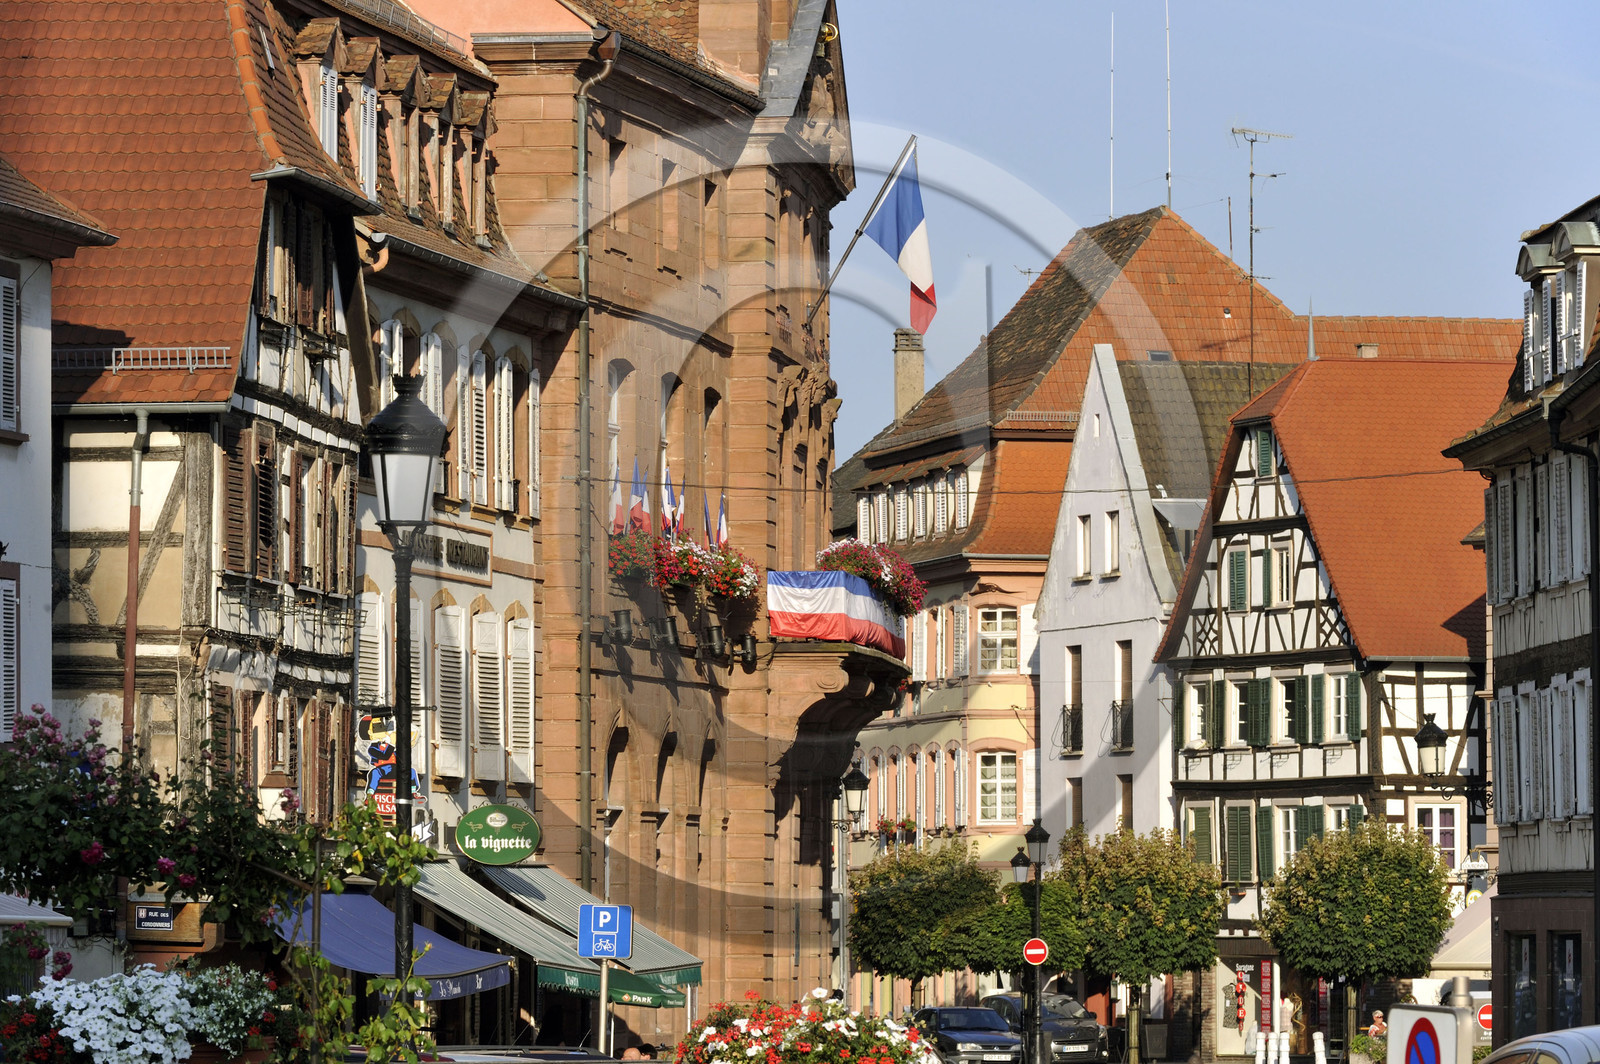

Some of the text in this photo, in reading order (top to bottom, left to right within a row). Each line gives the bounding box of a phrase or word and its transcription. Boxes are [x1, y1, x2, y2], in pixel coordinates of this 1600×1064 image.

[402, 530, 489, 568] BASSERIE RESTAURANT
[465, 835, 532, 853] la vignette
[599, 911, 611, 928] P
